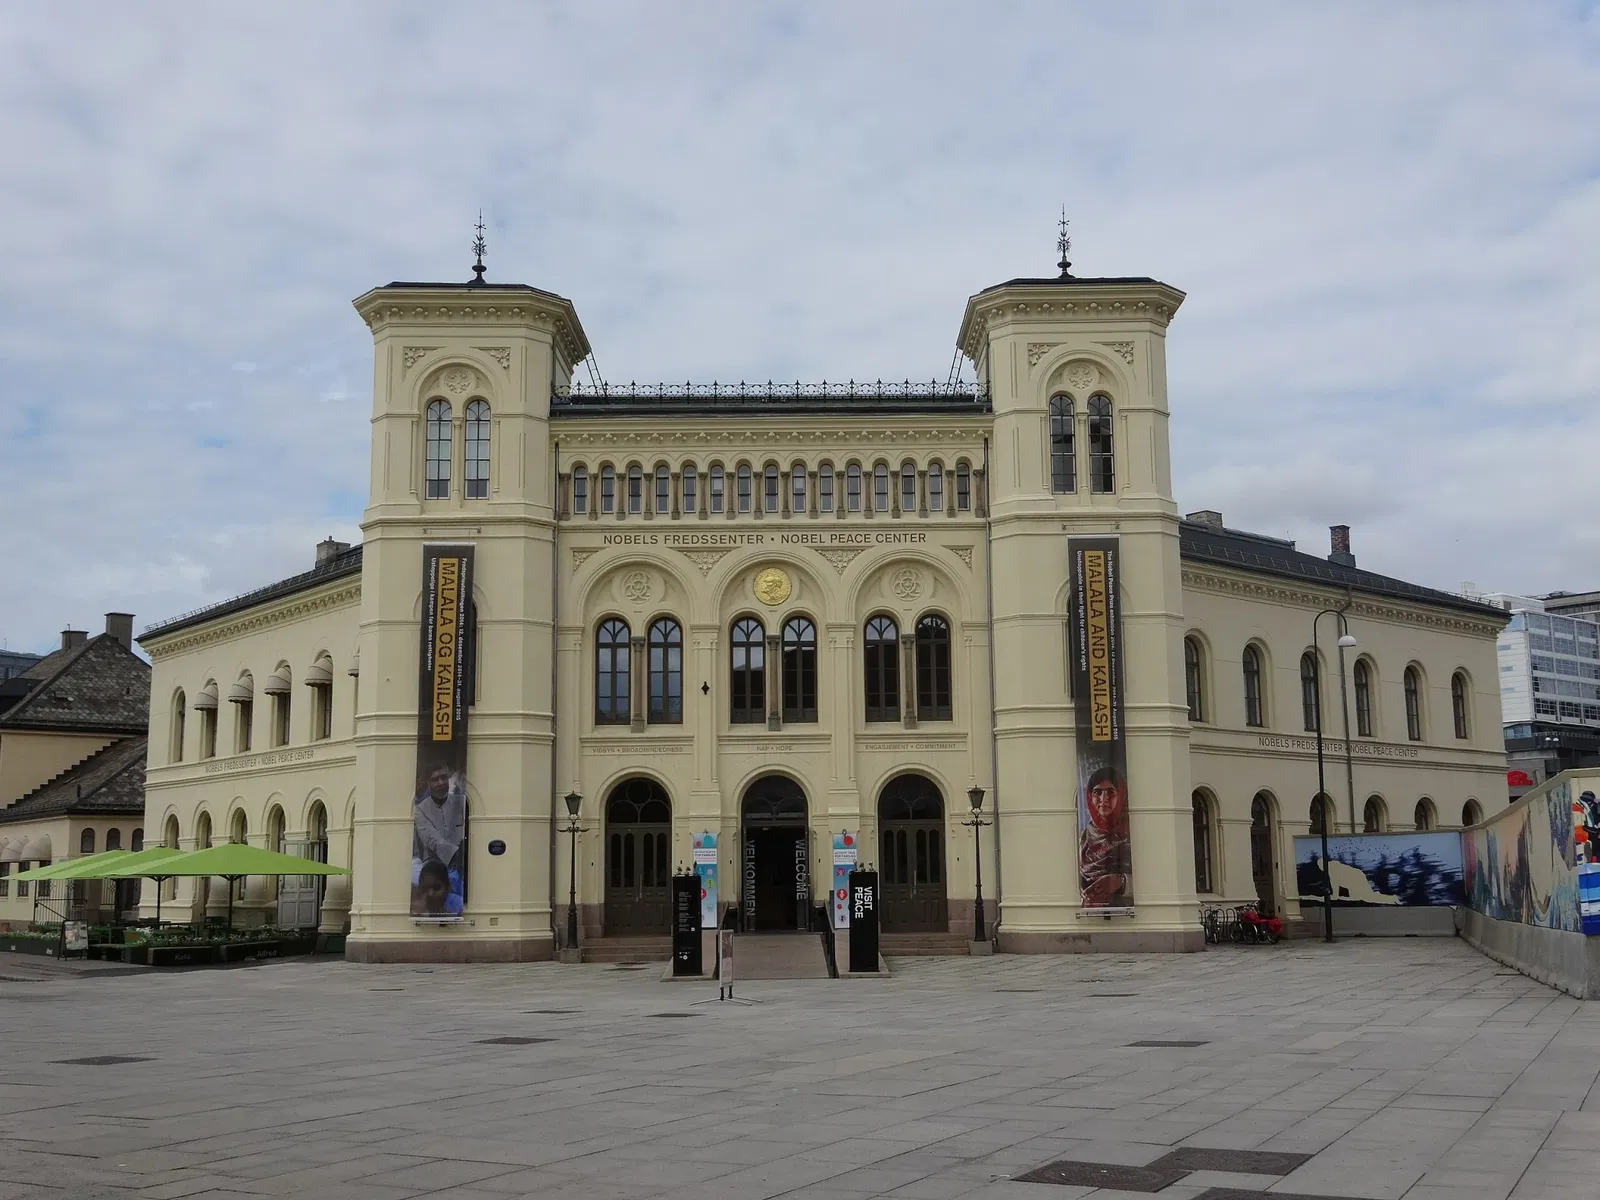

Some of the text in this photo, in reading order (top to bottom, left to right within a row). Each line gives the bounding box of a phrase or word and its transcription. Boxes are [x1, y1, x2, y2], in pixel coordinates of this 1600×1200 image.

[603, 532, 927, 545] NOBELS FREDSSENTER NOBEL PEACE CENTER
[436, 563, 456, 736] MALALA OG KAILASH
[1088, 555, 1108, 736] MALALA AND KAILASH
[205, 750, 314, 773] NOBELS FREDSSENTER NOBEL PEACE CENTER
[1258, 737, 1290, 748] NOBELS
[1350, 744, 1372, 755] NOBEL
[1373, 747, 1393, 756] PEACE
[1394, 748, 1418, 758] CENTER
[746, 840, 756, 916] VELKOMMEN
[796, 839, 807, 900] WELCOME
[855, 886, 864, 918] PEACE
[864, 886, 873, 910] VISIT
